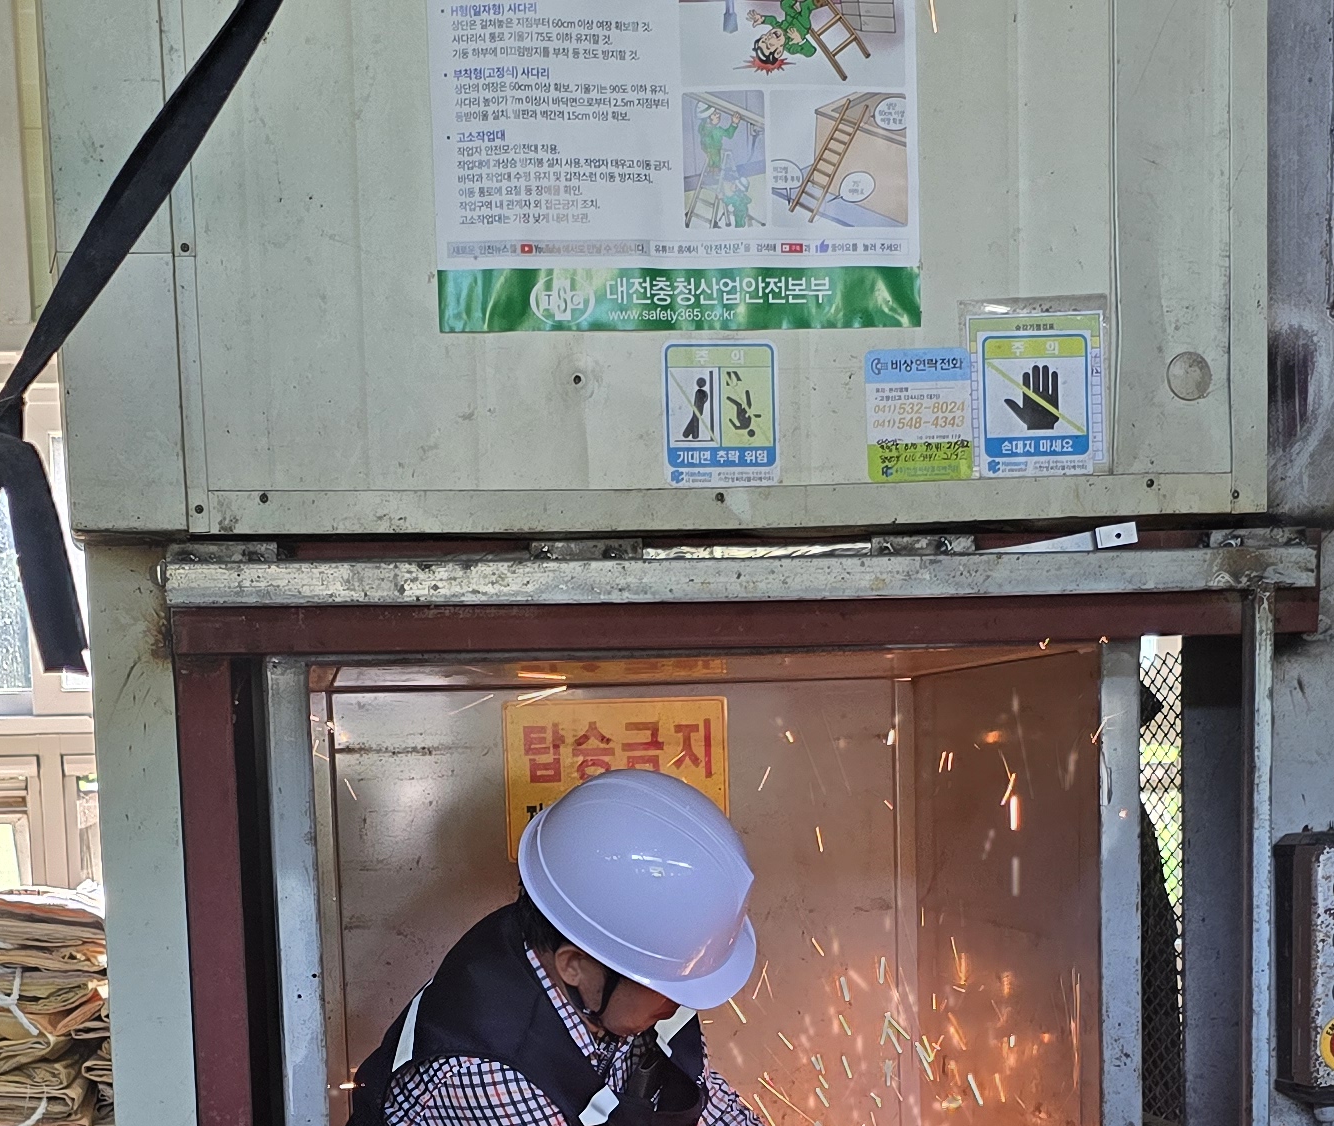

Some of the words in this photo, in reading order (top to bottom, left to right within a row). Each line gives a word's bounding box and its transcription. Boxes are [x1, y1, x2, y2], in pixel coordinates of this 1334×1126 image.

[451, 3, 504, 17] H형(일자형)
[507, 2, 537, 14] 사다리
[451, 19, 477, 31] 상단은
[516, 17, 550, 28] 지점부터
[552, 19, 575, 29] 60cm
[578, 20, 594, 30] 이상
[596, 20, 612, 31] 여장
[641, 21, 652, 32] 것.
[452, 32, 486, 44] 사다리식
[488, 32, 505, 43] 통로
[508, 31, 533, 42] 기울기
[535, 32, 554, 42] 75도
[556, 32, 572, 43] 이하
[575, 33, 599, 45] 유지할
[602, 34, 613, 45] 것.
[472, 47, 497, 58] 하부에
[552, 48, 568, 59] 부착
[572, 48, 580, 59] 등
[583, 48, 599, 59] 전도
[602, 49, 626, 60] 방지할
[629, 49, 640, 60] 것.
[454, 67, 518, 81] 부착형(고정식)
[521, 67, 550, 79] 사다리
[454, 83, 479, 95] 상단의
[482, 82, 507, 93] 여장은
[509, 83, 532, 93] 60cm
[535, 83, 551, 93] 이상
[574, 83, 607, 94] 기울기는
[609, 84, 628, 94] 90도
[631, 84, 647, 95] 이하
[455, 97, 480, 108] 사다리
[483, 96, 508, 106] 높이가
[510, 96, 523, 105] 7m
[525, 95, 550, 106] 이상시
[552, 96, 611, 108] 바닥면으로부터
[613, 98, 634, 108] 2.5m
[637, 98, 669, 109] 지점부터
[567, 111, 590, 121] 15cm
[592, 111, 609, 122] 이상
[457, 129, 505, 143] 고소작업대
[457, 146, 482, 157] 작업자
[457, 158, 490, 170] 작업대에
[546, 158, 562, 168] 설치
[584, 158, 608, 169] 작업자
[610, 159, 635, 170] 태우고
[637, 159, 651, 170] 이동
[458, 173, 483, 184] 바닥과
[486, 172, 511, 183] 작업대
[534, 172, 550, 182] 유지
[564, 172, 597, 182] 갑작스런
[600, 172, 615, 183] 이동
[618, 173, 653, 184] 방지조치.
[459, 187, 475, 198] 이동
[478, 186, 502, 197] 통로에
[524, 185, 532, 197] 등
[460, 200, 492, 212] 작업구역
[495, 200, 503, 210] 내
[506, 199, 531, 210] 관계자
[534, 199, 542, 210] 외
[544, 199, 578, 210] 접근금지
[460, 214, 510, 225] 고소작업대는
[513, 214, 530, 224] 가장
[533, 213, 550, 224] 낮게
[606, 276, 833, 305] 대전충청산업안전본부
[608, 308, 735, 323] www.safety365.co.kr
[891, 357, 963, 372] 비상연락전화
[1001, 441, 1035, 454] 손대지
[1040, 439, 1073, 453] 마세요
[677, 451, 710, 464] 기대면
[717, 450, 739, 463] 추락
[745, 450, 767, 463] 위험
[523, 718, 713, 784] 탑승금지
